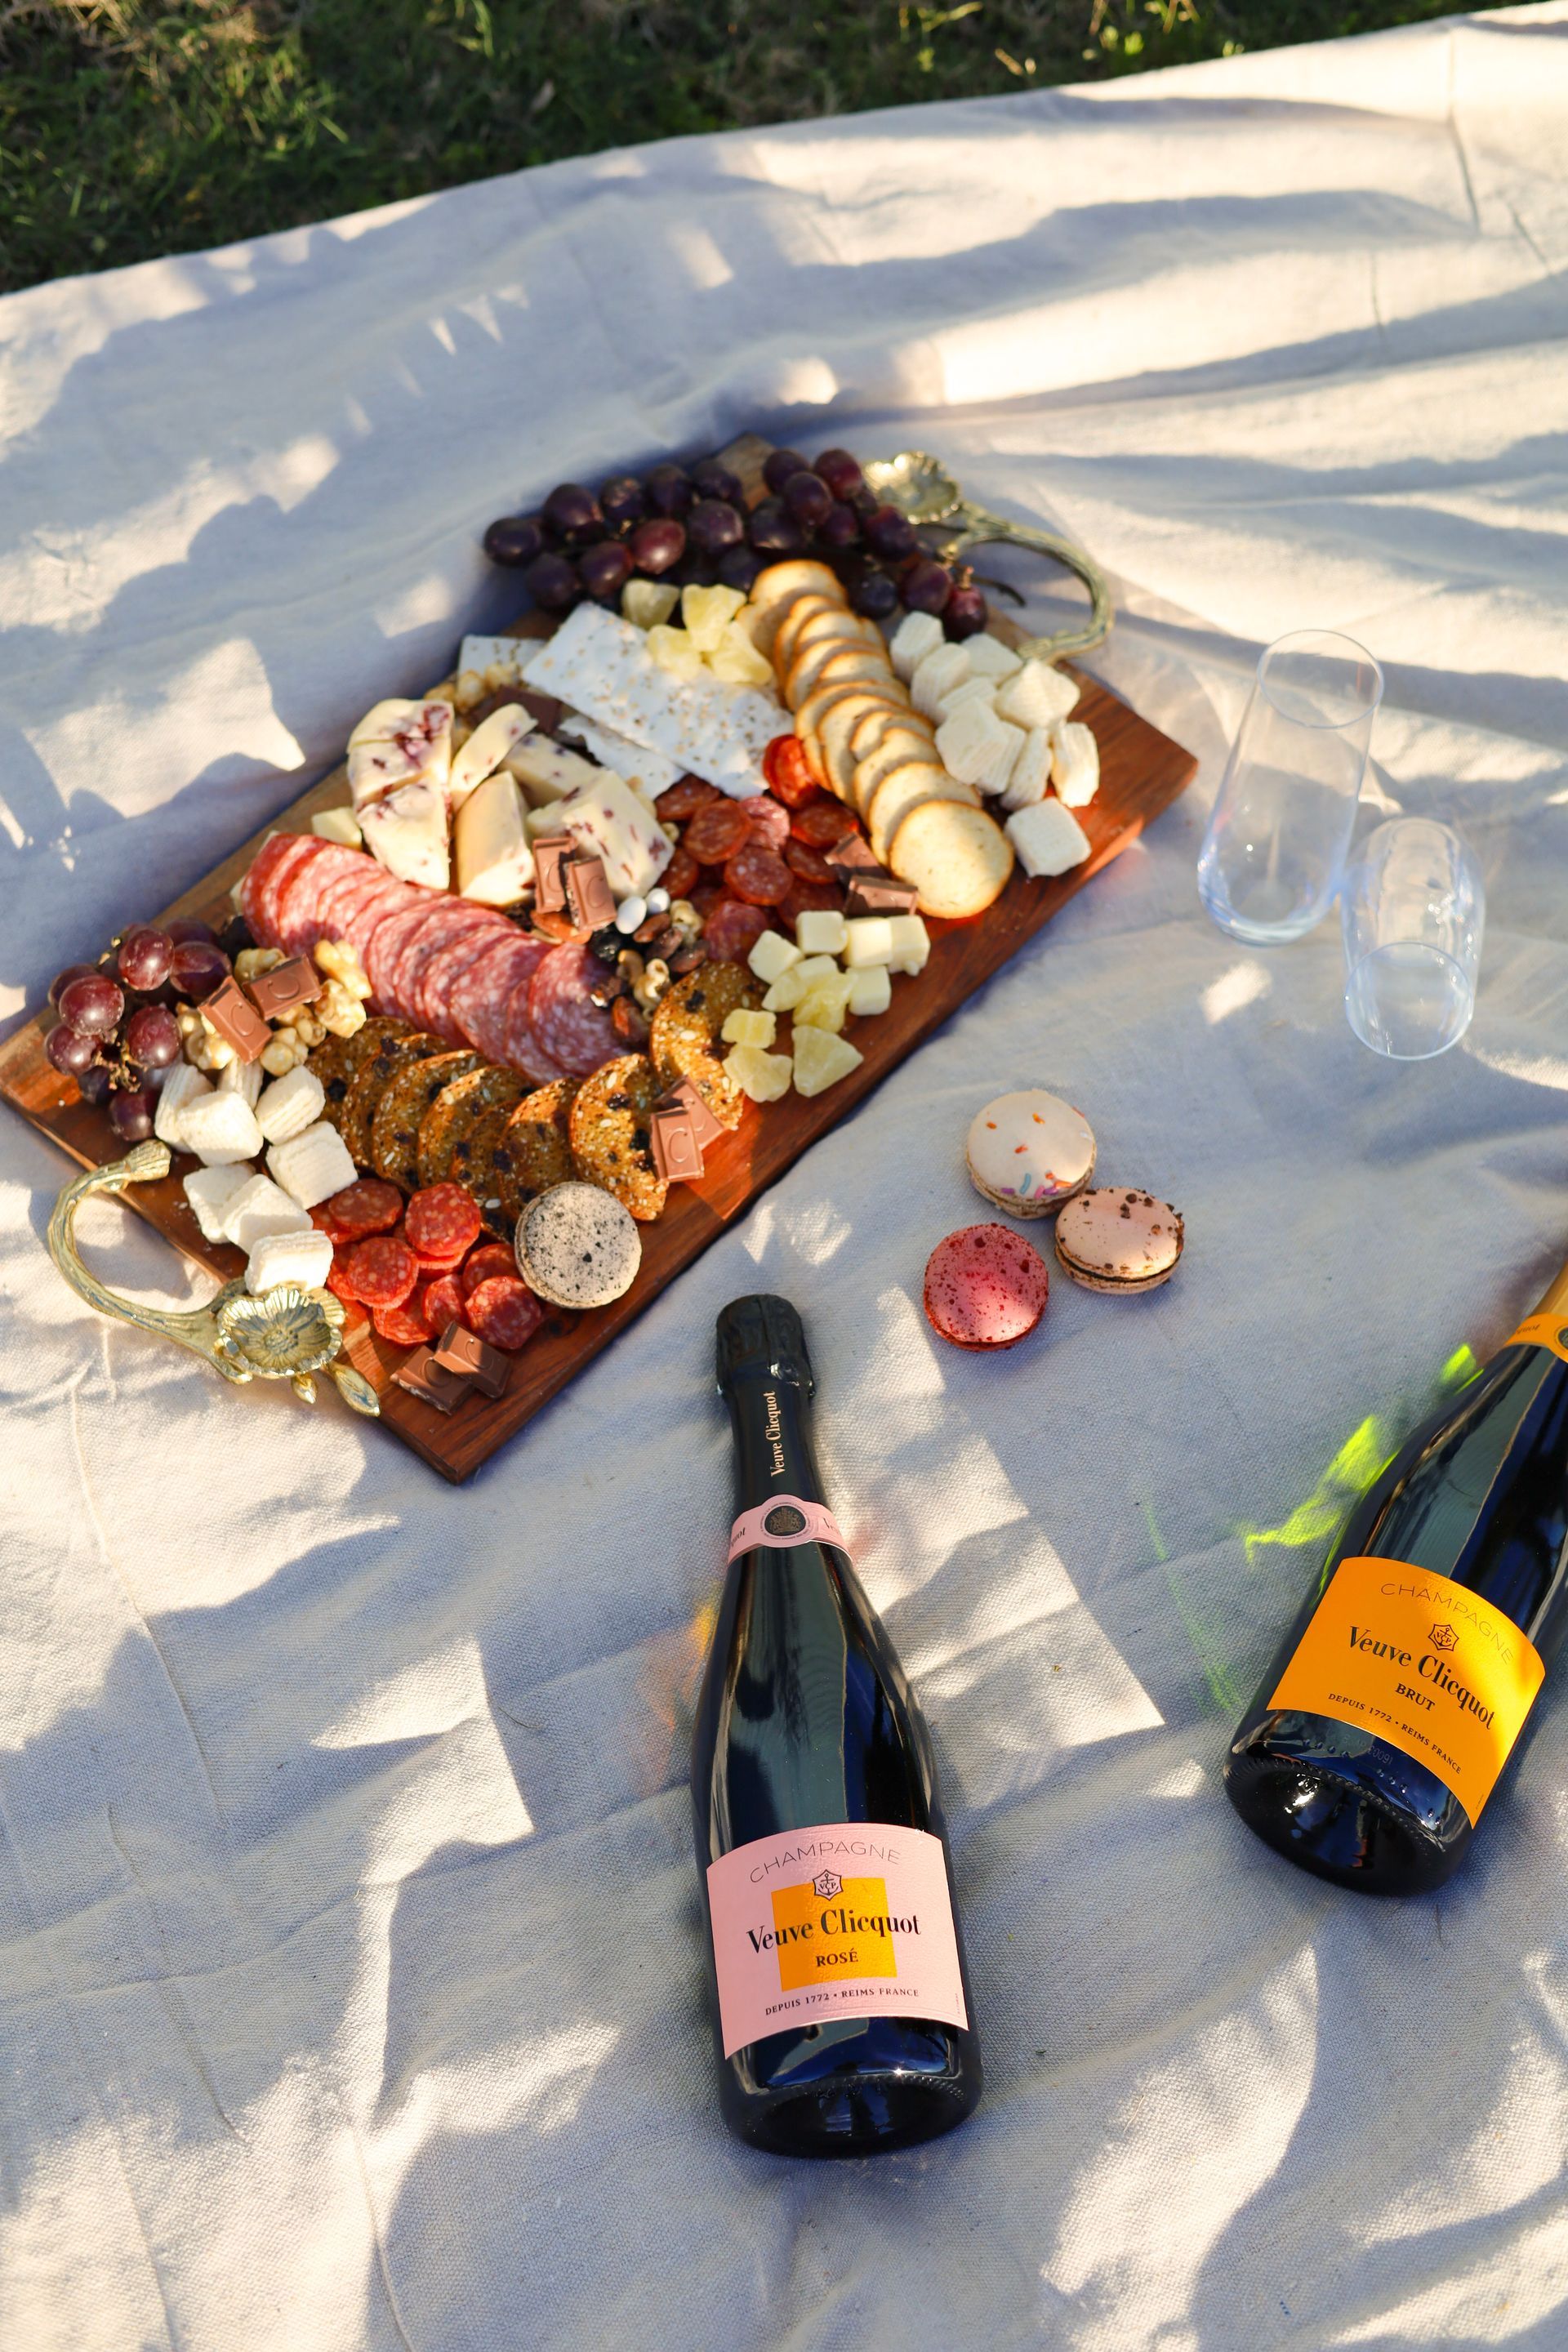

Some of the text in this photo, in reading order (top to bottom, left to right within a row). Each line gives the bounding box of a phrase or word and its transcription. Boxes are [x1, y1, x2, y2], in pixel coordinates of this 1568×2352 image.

[764, 1391, 785, 1477] Veuve Clicquot
[1380, 1583, 1514, 1665] CHAMPAGNE
[1349, 1626, 1495, 1731] Veuve Clicquot
[1395, 1682, 1435, 1712] BRUT
[1328, 1693, 1461, 1775] DEPUIS 1772 REIMS FRANCE
[750, 1841, 901, 1883] CHAMPAGNE
[746, 1909, 922, 1954] Veuve Clicquot
[816, 1948, 858, 1967] ROSÉ
[765, 1988, 919, 2016] DEPUIS 1772 REIMS FRANCE
